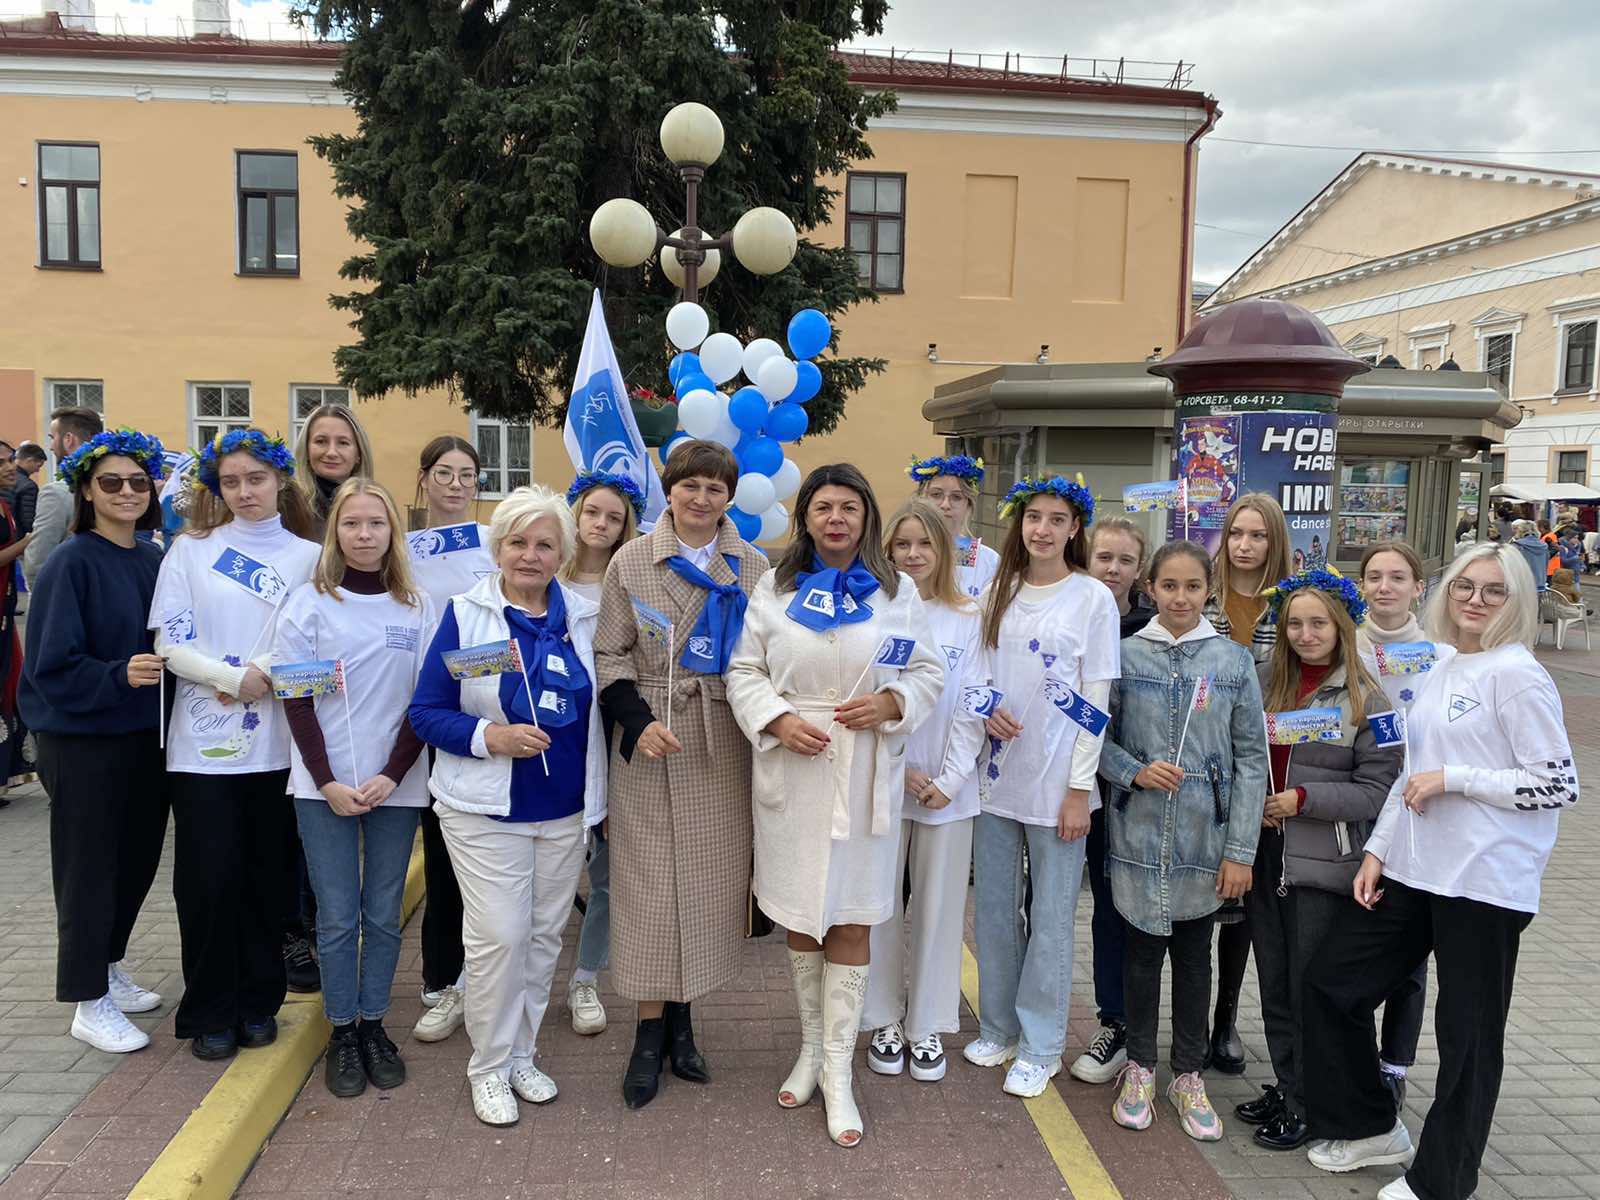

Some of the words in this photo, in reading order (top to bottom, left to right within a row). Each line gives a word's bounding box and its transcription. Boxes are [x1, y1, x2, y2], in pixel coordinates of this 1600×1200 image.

[1233, 395, 1284, 405] 68-41-12
[1367, 419, 1424, 429] ОТКРЫТКИ
[1291, 516, 1325, 529] dance
